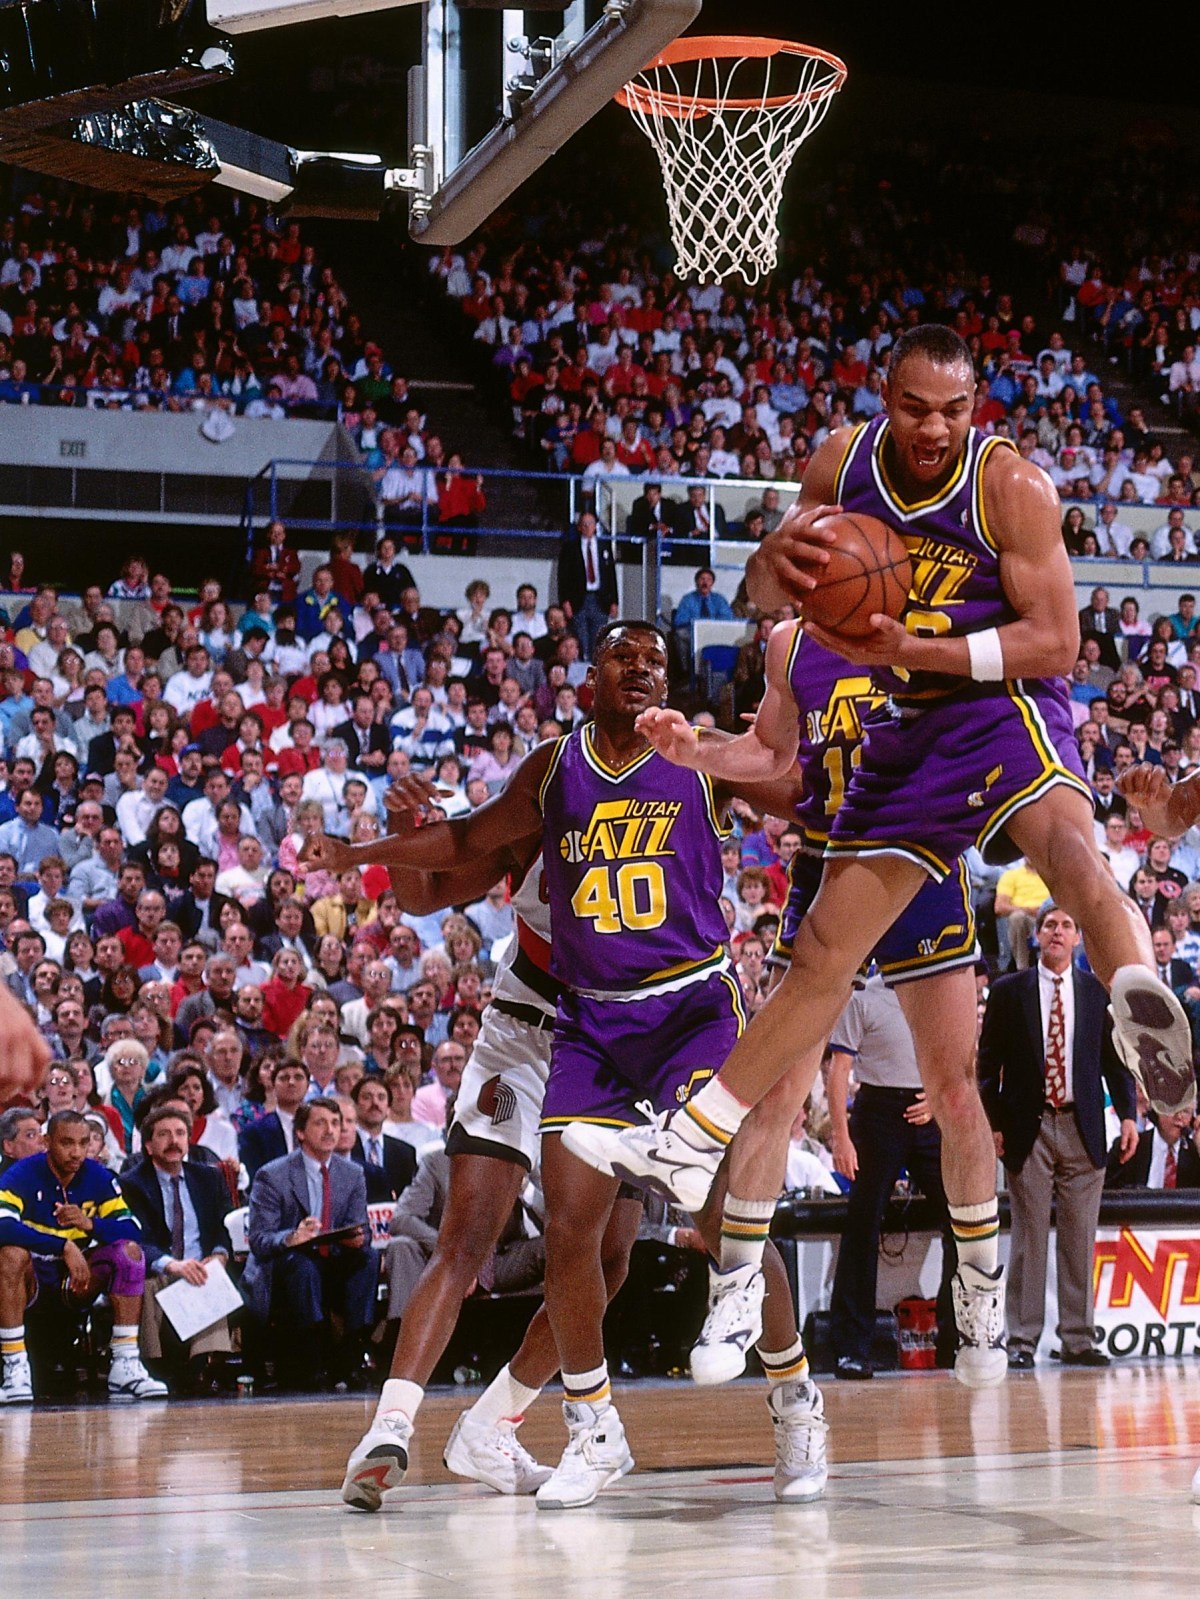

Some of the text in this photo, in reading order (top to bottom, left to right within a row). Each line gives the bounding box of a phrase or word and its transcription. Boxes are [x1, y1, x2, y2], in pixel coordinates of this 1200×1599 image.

[60, 440, 87, 457] EXIT
[631, 801, 682, 816] UTAH
[571, 861, 667, 934] 40
